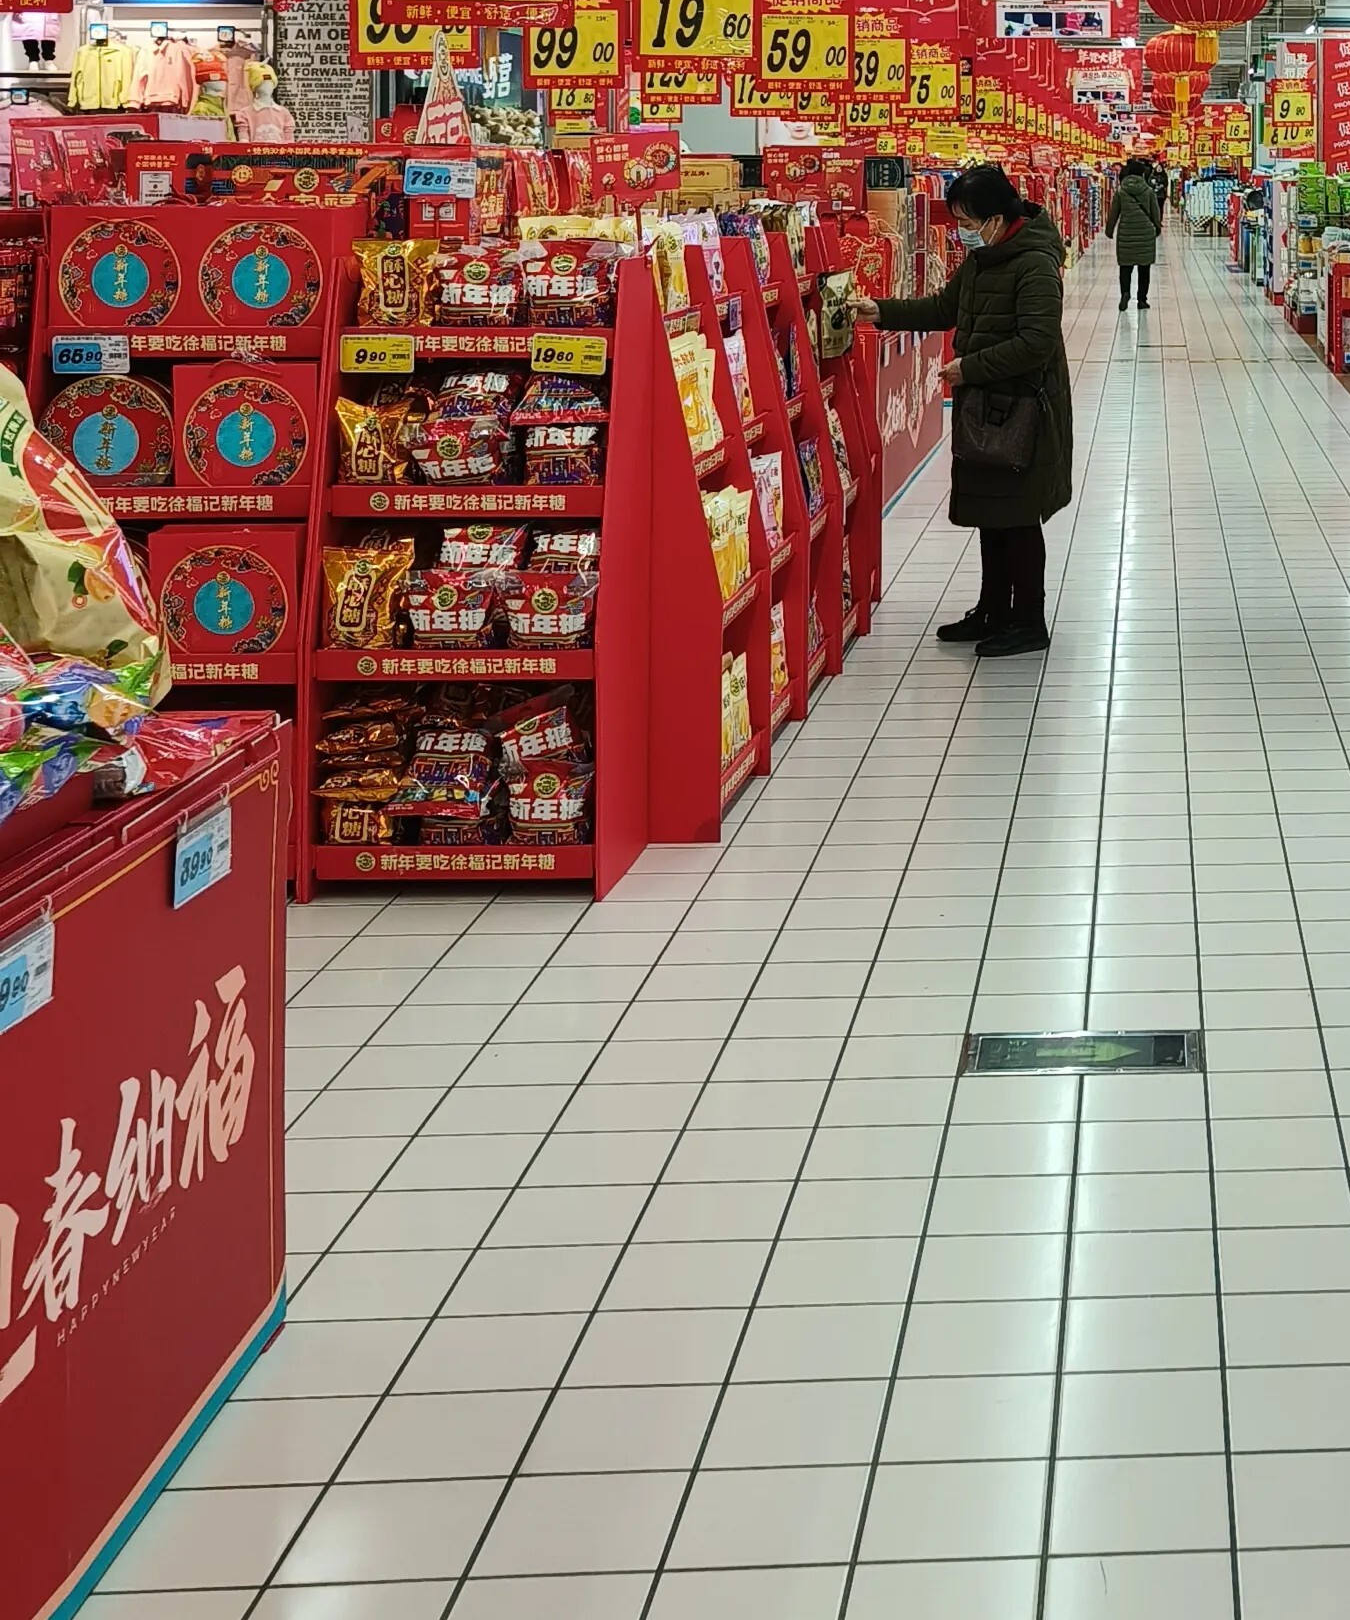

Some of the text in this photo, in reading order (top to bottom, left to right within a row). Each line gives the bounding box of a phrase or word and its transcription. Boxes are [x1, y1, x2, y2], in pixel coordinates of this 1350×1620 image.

[533, 27, 614, 69] 99 00
[825, 46, 847, 67] 00
[394, 494, 566, 512] 新年要吃徐福记新年糖
[381, 658, 557, 675] 新年要吃徐福记新年糖
[381, 854, 556, 871] 新年要吃徐福记新年糖
